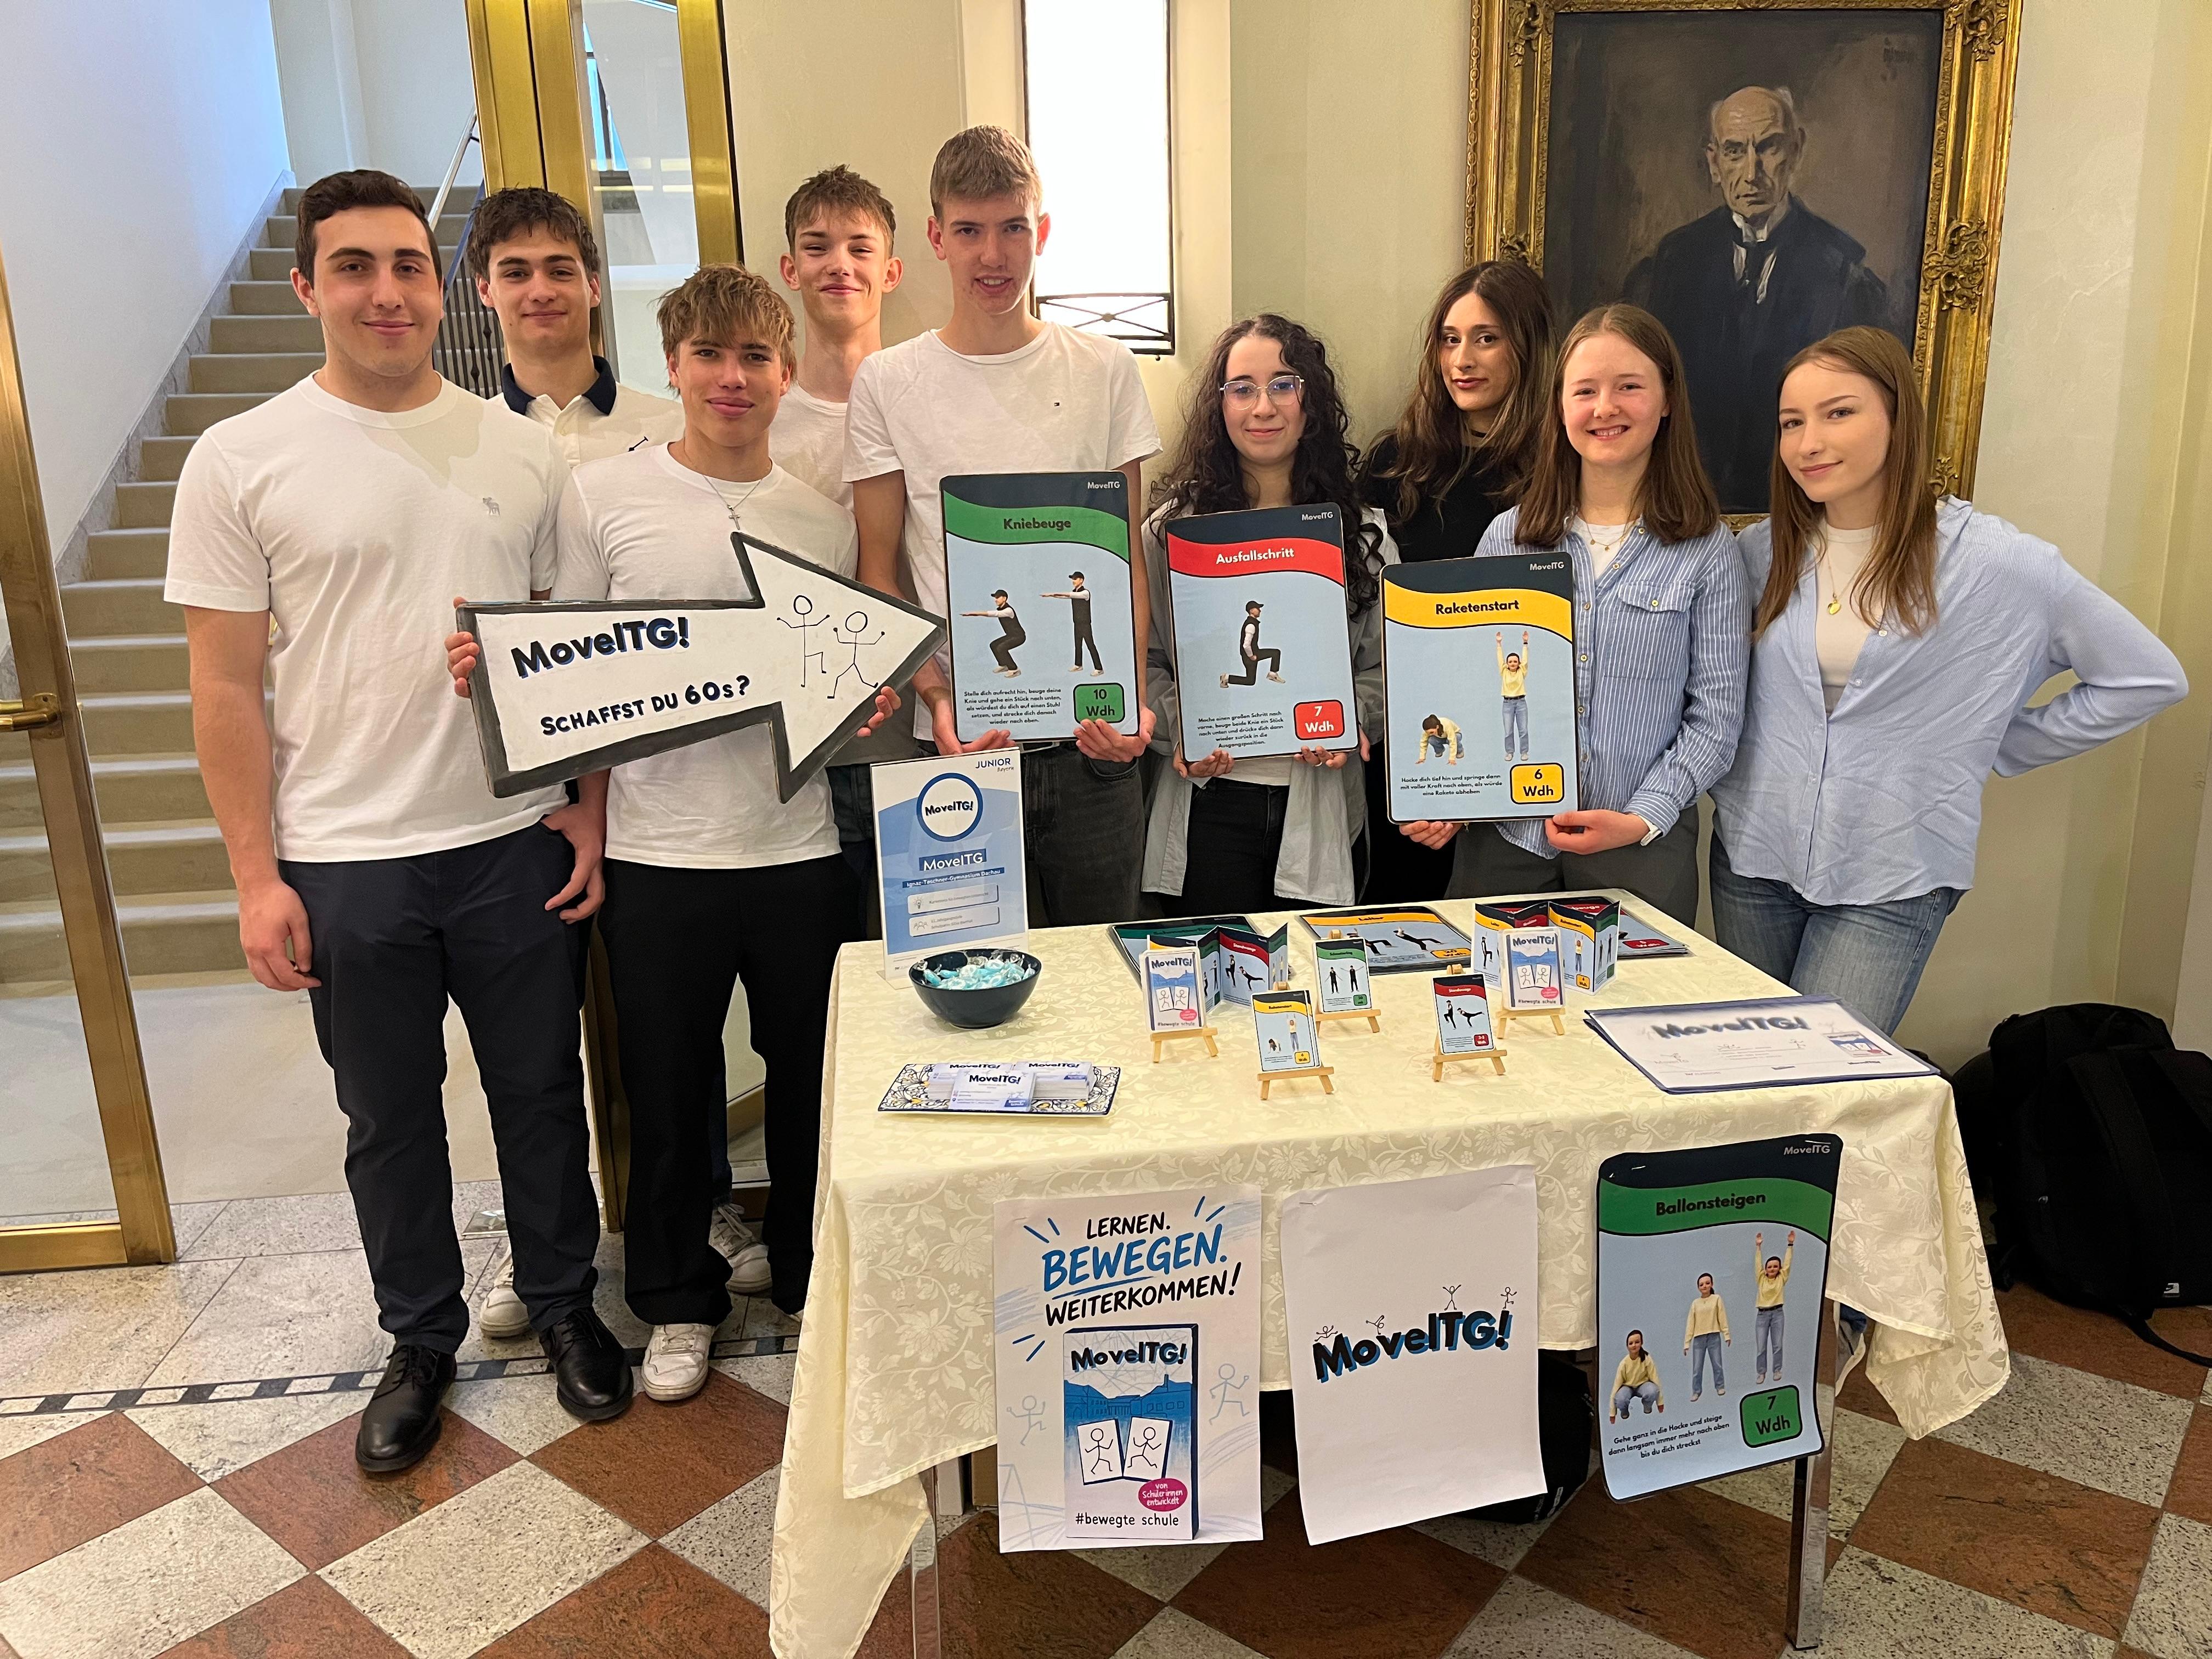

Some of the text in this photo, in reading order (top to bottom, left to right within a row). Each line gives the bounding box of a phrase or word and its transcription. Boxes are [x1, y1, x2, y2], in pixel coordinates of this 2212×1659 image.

[1301, 511, 1334, 521] MoveITG
[1003, 518, 1071, 531] Kniebeuge
[1216, 548, 1295, 565] Ausfallschritt
[1530, 562, 1565, 571] MoveITG
[1435, 600, 1520, 615] Raketenstart
[510, 616, 690, 679] MoveITG!
[1093, 689, 1107, 700] 10
[540, 699, 646, 736] SCHAFFST
[650, 692, 678, 713] DU
[1086, 705, 1115, 716] Wdh
[1314, 706, 1323, 716] 7
[1305, 721, 1334, 733] Wdh
[975, 758, 1011, 769] JUNIOR
[1534, 769, 1543, 780] 6
[1523, 785, 1554, 796] Wdh
[925, 801, 973, 816] MoveITG!
[923, 853, 983, 872] MoveITG
[1513, 935, 1555, 947] MoveITG!
[1152, 958, 1192, 969] MoveITG!
[969, 1075, 1021, 1084] MoveITG!
[1783, 1144, 1831, 1156] MoveITG
[1655, 1193, 1766, 1216] Ballonsteigen
[1086, 1212, 1171, 1240] LERNEN.
[1042, 1223, 1227, 1291] BEWEGEN.
[1045, 1262, 1242, 1327] WEITERKOMMEN!
[1313, 1310, 1513, 1383] MoveITG!
[1071, 1341, 1187, 1372] MoveITG!
[1766, 1396, 1777, 1410] 7
[1633, 1433, 1648, 1441] ganz
[1669, 1422, 1688, 1431] Hocke
[1690, 1418, 1702, 1426] und
[1704, 1415, 1722, 1423] steige
[1755, 1415, 1791, 1435] Wdh
[1627, 1441, 1655, 1451] langsam
[1656, 1436, 1677, 1444] immer
[1679, 1430, 1695, 1438] mehr
[1714, 1423, 1729, 1431] oben
[1677, 1439, 1701, 1449] streckst
[1147, 1497, 1180, 1506] entwickelt
[1075, 1513, 1179, 1527] #bewegte schule
